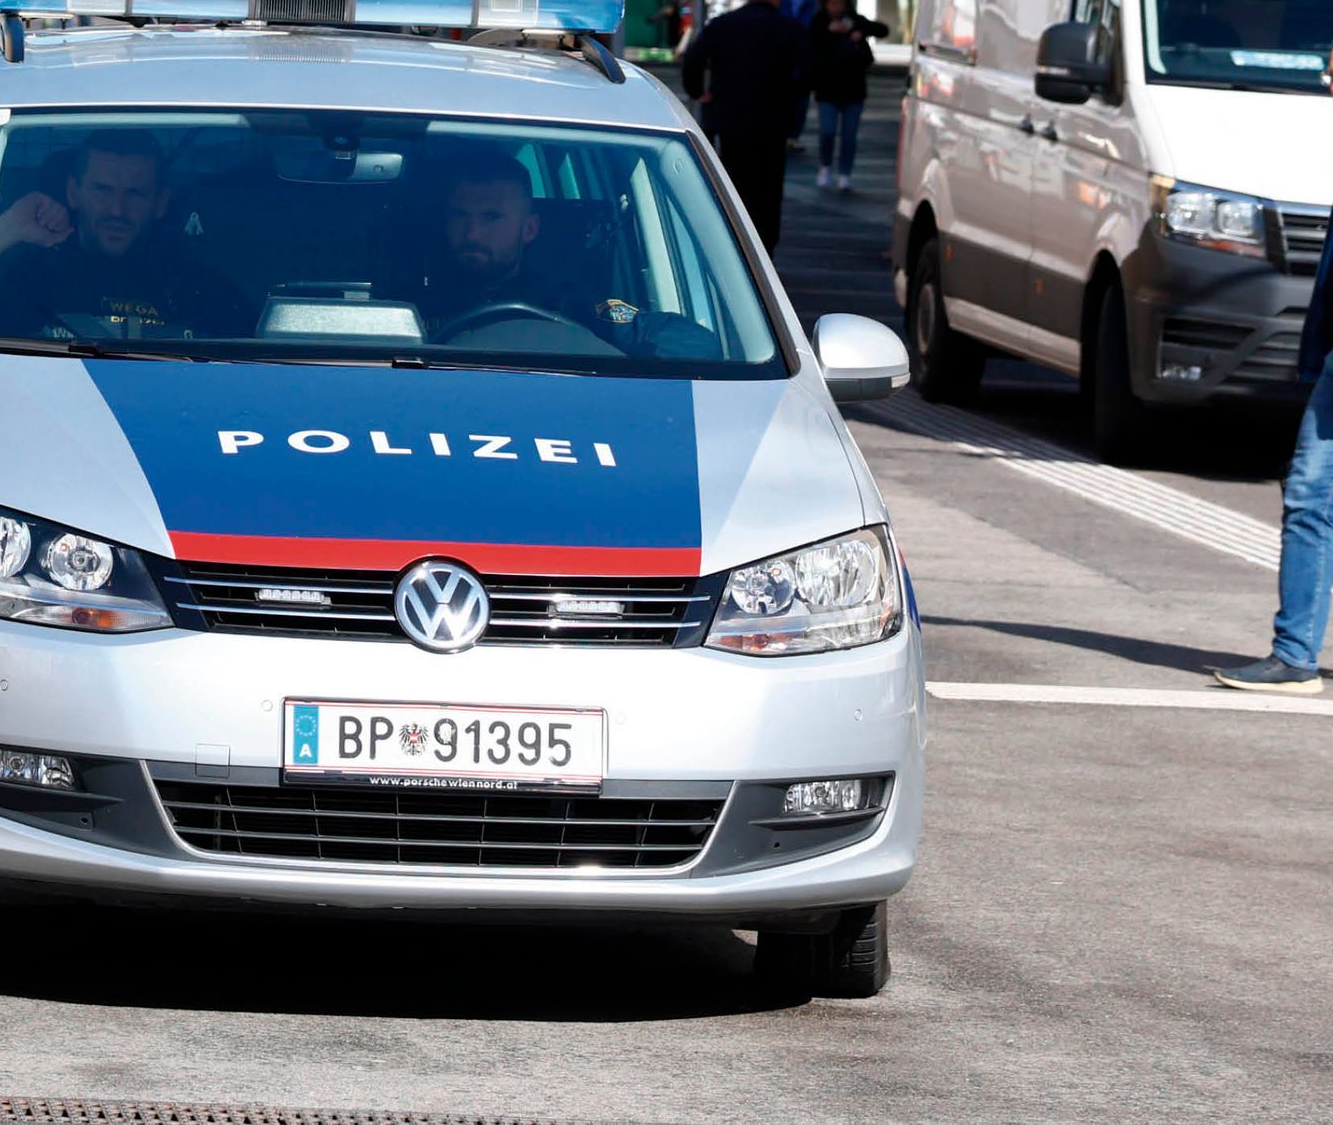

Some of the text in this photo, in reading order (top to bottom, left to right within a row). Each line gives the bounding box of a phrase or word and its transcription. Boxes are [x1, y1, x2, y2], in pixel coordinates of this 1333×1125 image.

[217, 429, 617, 468] POLIZEI
[298, 715, 573, 767] A BP 91395
